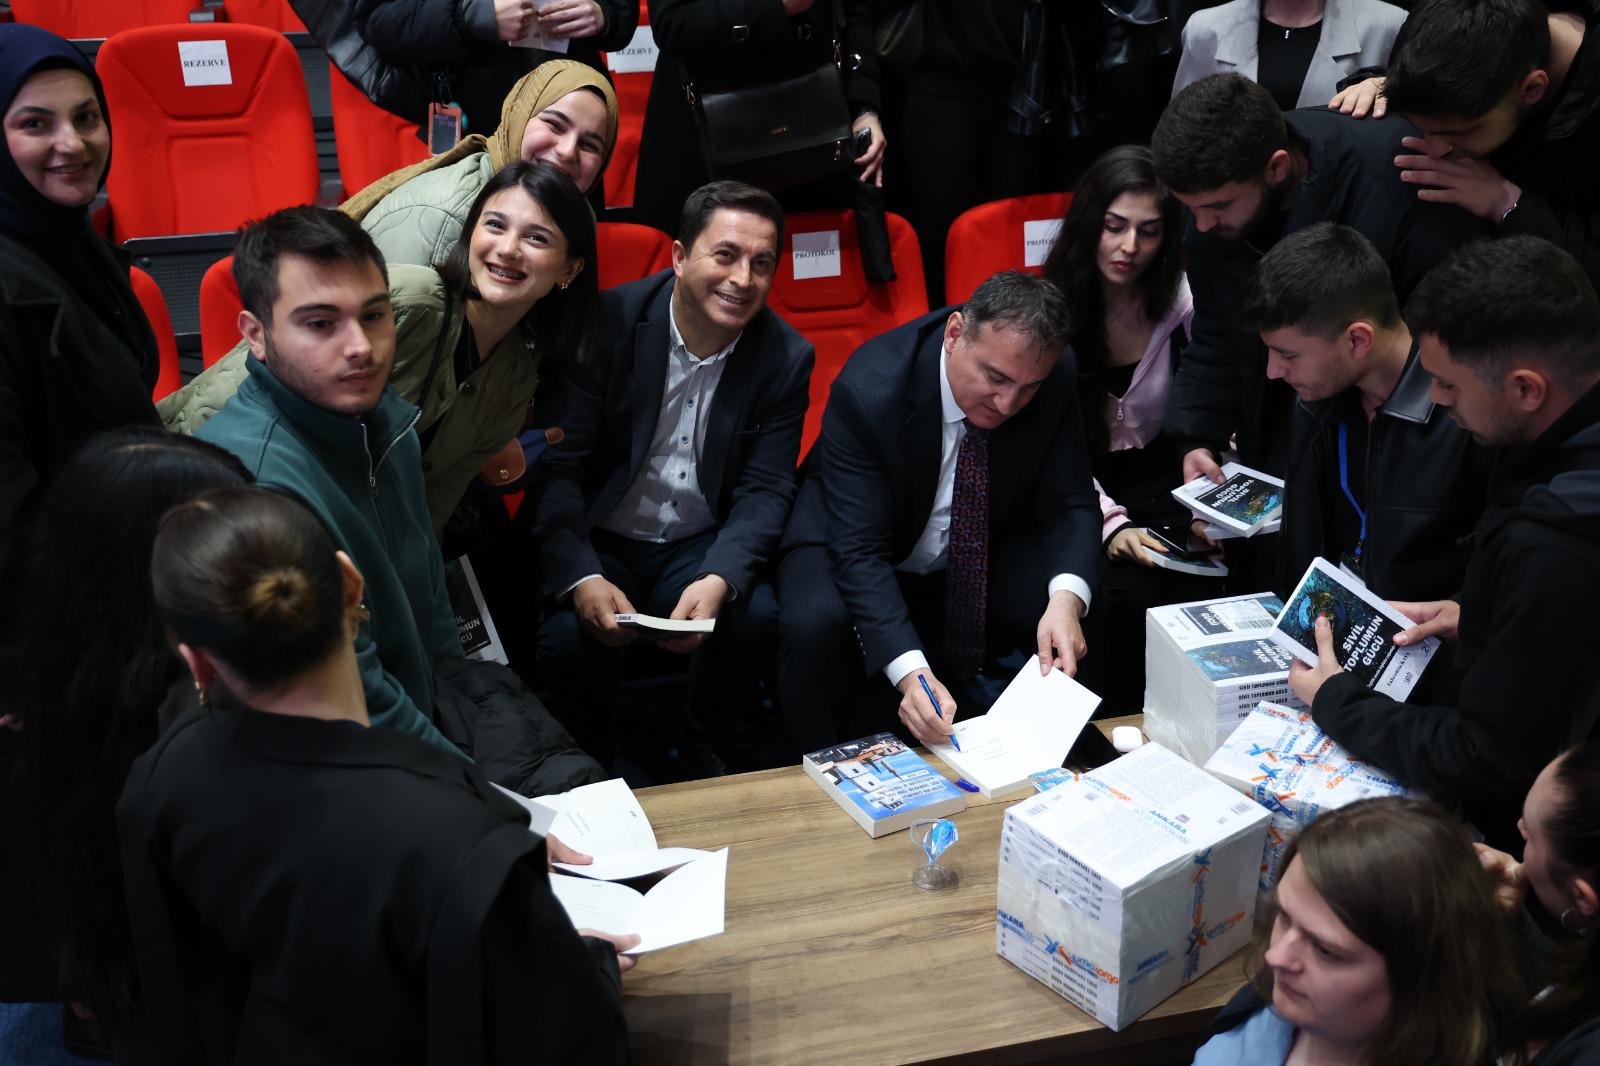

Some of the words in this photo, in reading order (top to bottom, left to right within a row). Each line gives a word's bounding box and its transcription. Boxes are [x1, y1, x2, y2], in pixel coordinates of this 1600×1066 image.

[183, 59, 226, 68] REZERVE
[795, 248, 837, 259] PROTOKOL
[1342, 624, 1365, 652] SİVİL
[1343, 615, 1384, 672] TOPLUMUN
[1362, 635, 1385, 666] GÜCÜ
[1149, 810, 1187, 836] ANKARA
